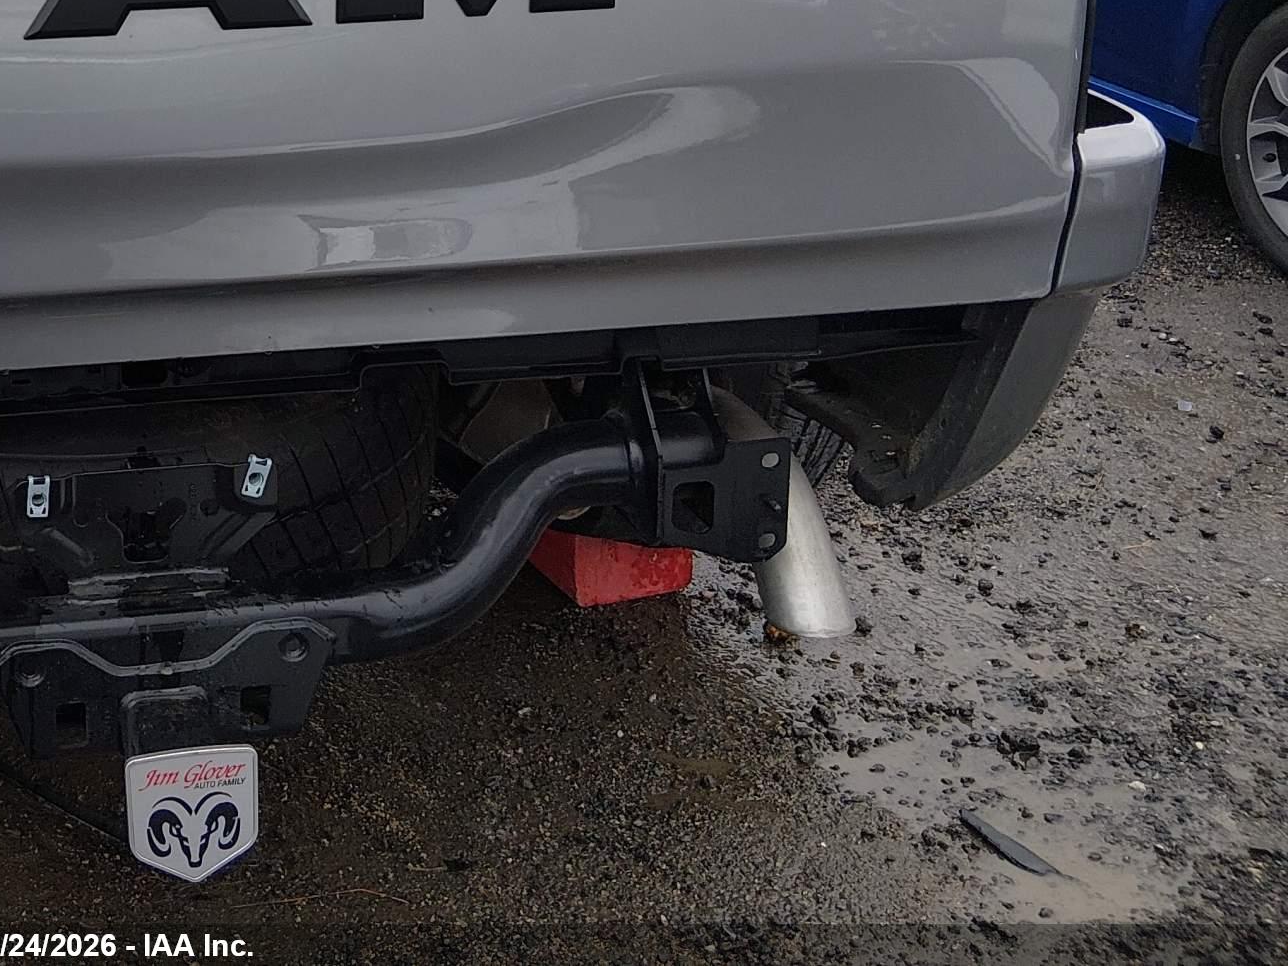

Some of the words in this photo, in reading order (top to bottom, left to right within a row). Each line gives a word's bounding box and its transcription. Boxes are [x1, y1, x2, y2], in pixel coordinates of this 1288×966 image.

[138, 769, 179, 791] Jim
[183, 760, 247, 789] Glover
[194, 779, 216, 790] AUTO
[217, 777, 247, 789] FAMILY
